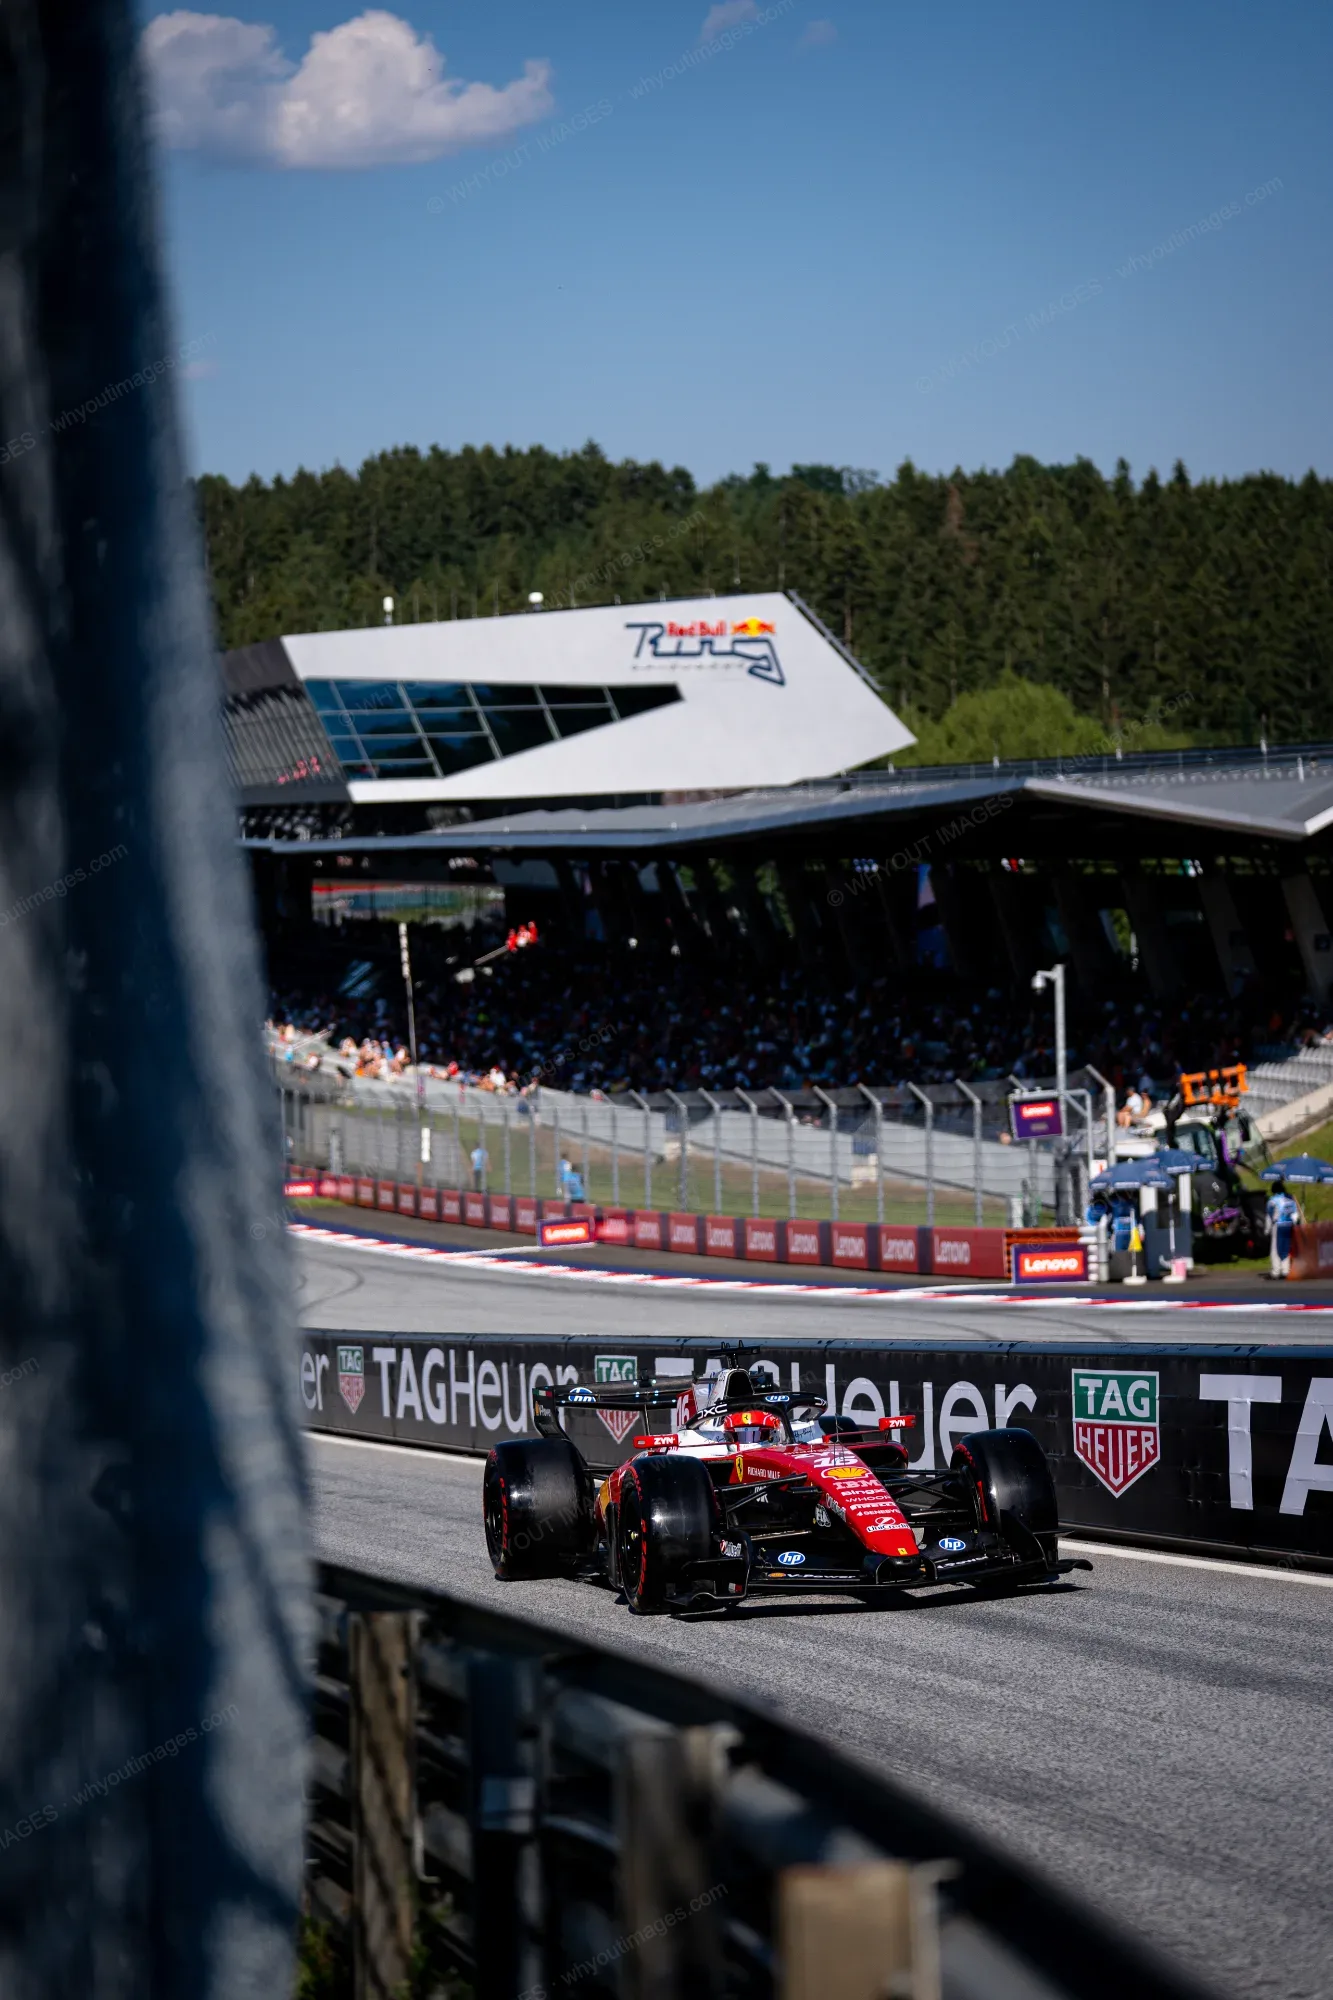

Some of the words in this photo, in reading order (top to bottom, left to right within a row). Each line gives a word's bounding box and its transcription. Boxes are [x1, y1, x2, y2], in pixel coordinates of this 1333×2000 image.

[666, 621, 694, 637] Red
[699, 620, 727, 637] Bull
[624, 622, 786, 686] Ring
[881, 1233, 916, 1261] Lenovo
[934, 1233, 971, 1265] Lenovo
[1024, 1257, 1078, 1273] Lenovo
[340, 1350, 362, 1372] TAG
[598, 1361, 634, 1382] TAG
[1078, 1377, 1151, 1419] TAG
[676, 1395, 690, 1429] 16
[889, 1420, 906, 1428] ZYN
[653, 1437, 674, 1445] ZYN
[1199, 1373, 1333, 1516] TA
[1077, 1426, 1155, 1486] HEUER
[747, 1466, 767, 1478] RICHARD
[767, 1469, 781, 1479] MILLE
[833, 1480, 882, 1490] IBM
[944, 1538, 962, 1550] hp
[783, 1553, 802, 1565] hp
